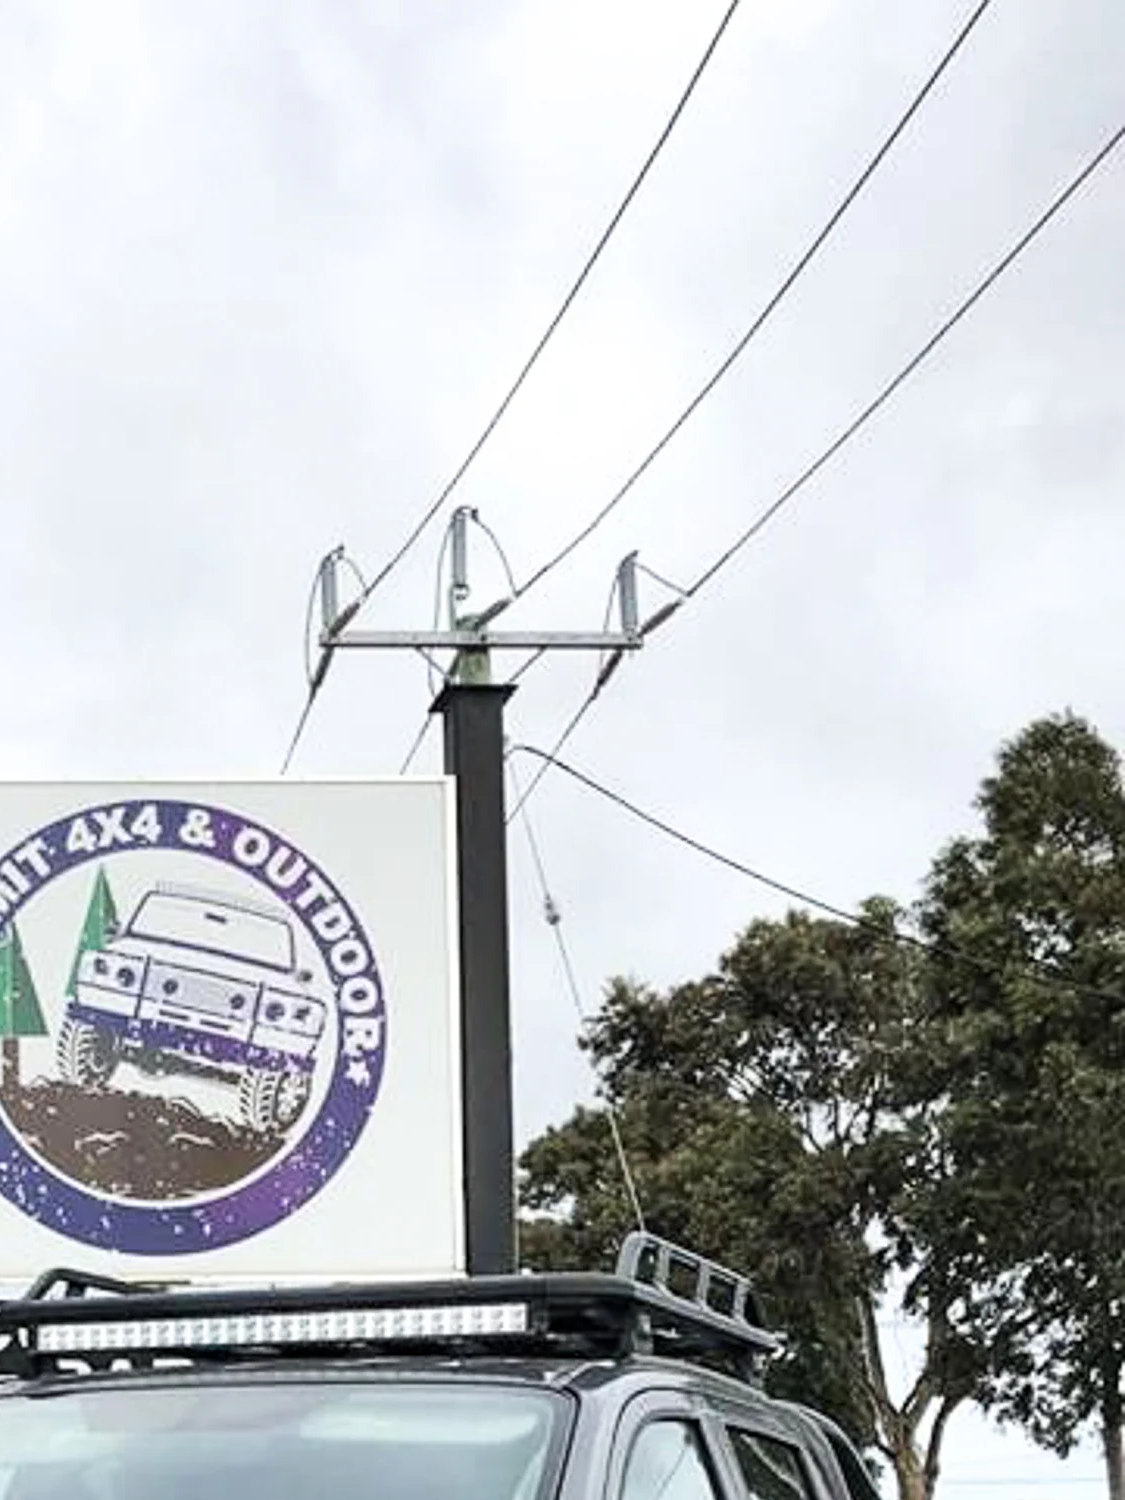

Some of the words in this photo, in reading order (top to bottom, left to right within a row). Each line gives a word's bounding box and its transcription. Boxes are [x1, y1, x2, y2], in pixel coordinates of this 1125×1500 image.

[65, 804, 163, 852] 4X4
[178, 807, 217, 849] &
[231, 825, 382, 1057] OUTDOOR
